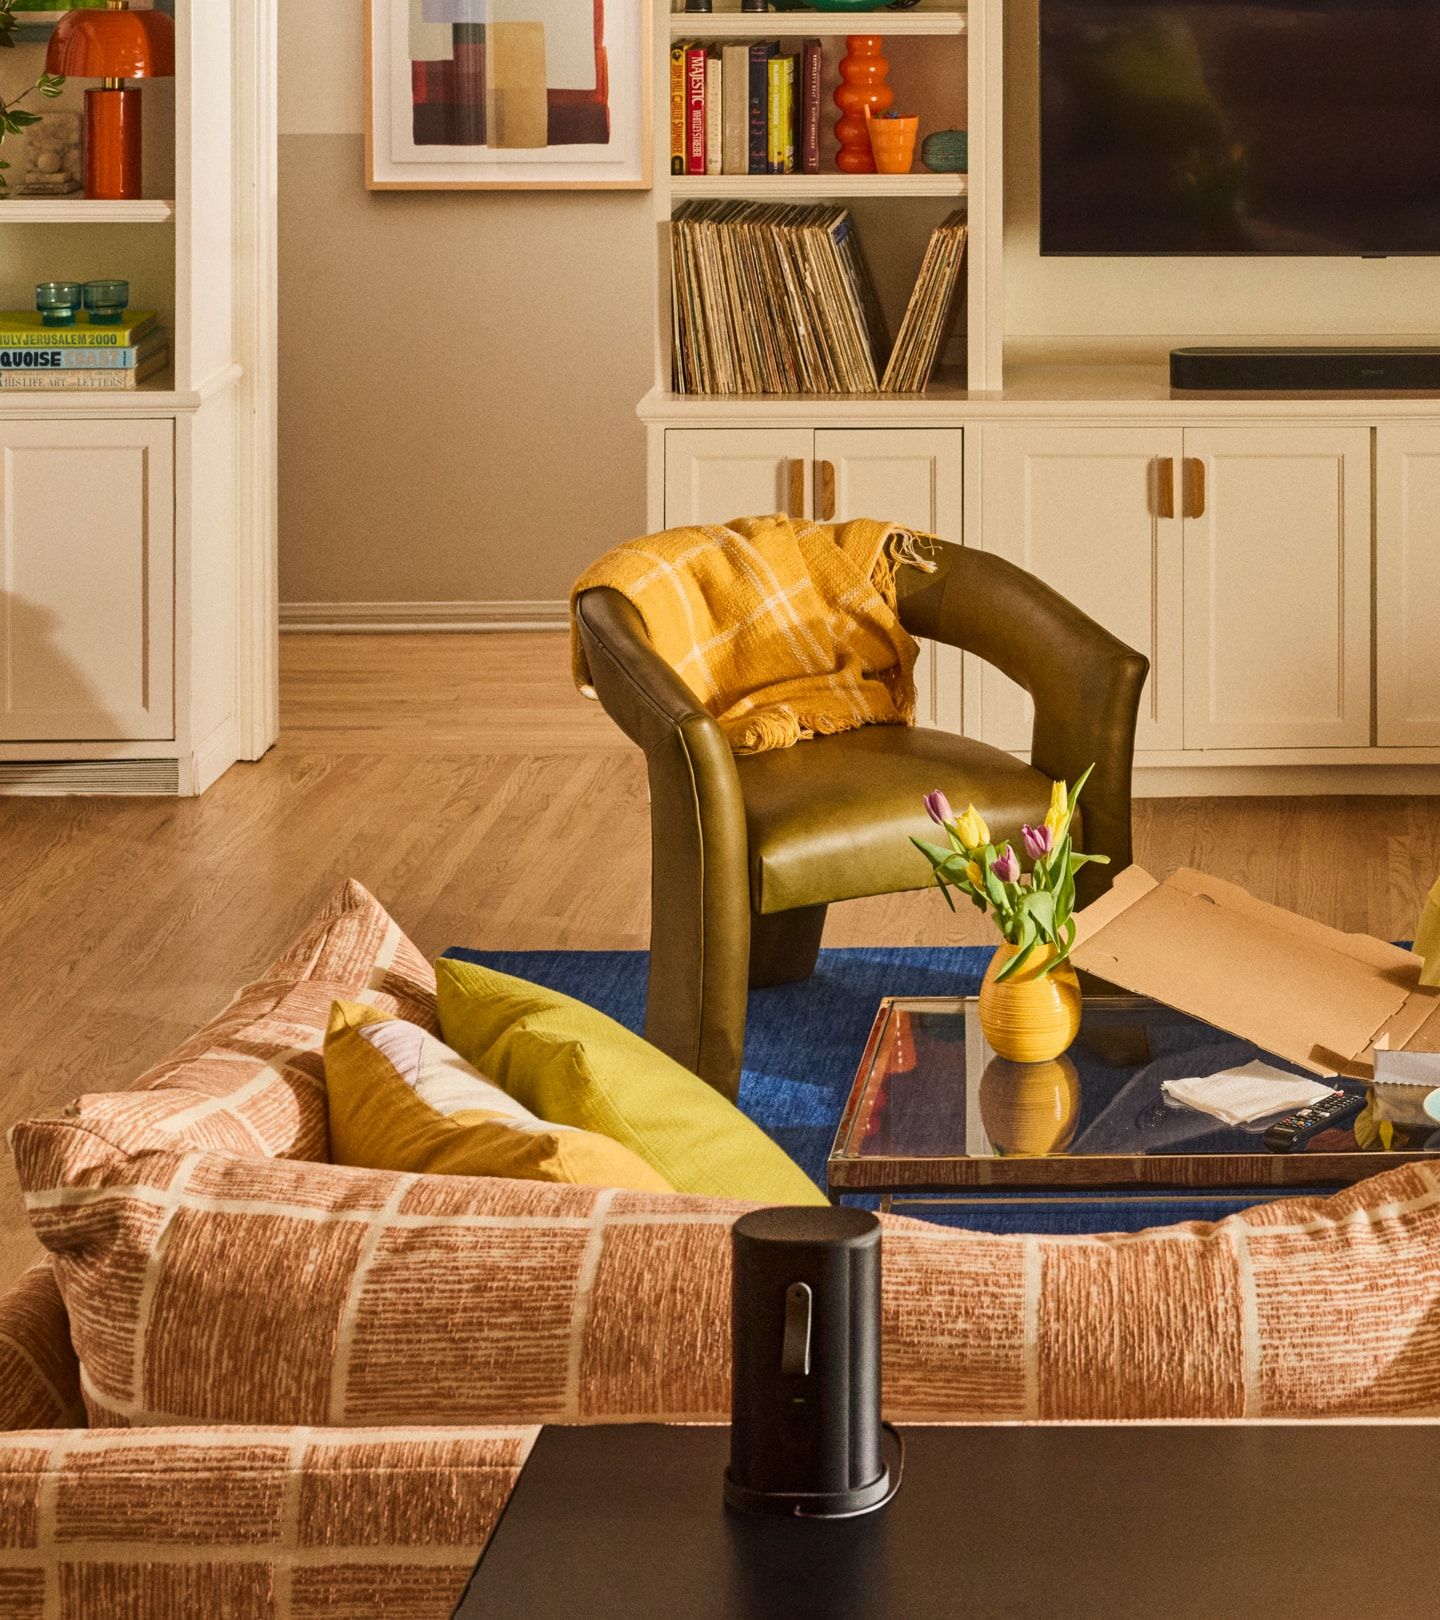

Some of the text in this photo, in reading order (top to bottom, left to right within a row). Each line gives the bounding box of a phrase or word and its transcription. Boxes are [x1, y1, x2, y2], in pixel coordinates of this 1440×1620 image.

[671, 80, 683, 93] HALL
[689, 56, 704, 158] MAJESTIC WHITLEY STRIEBER
[23, 334, 87, 345] JERUSALEM
[89, 334, 118, 345] 2000
[0, 351, 61, 367] QUOISE
[48, 378, 67, 387] ART
[77, 378, 124, 387] LETTERS
